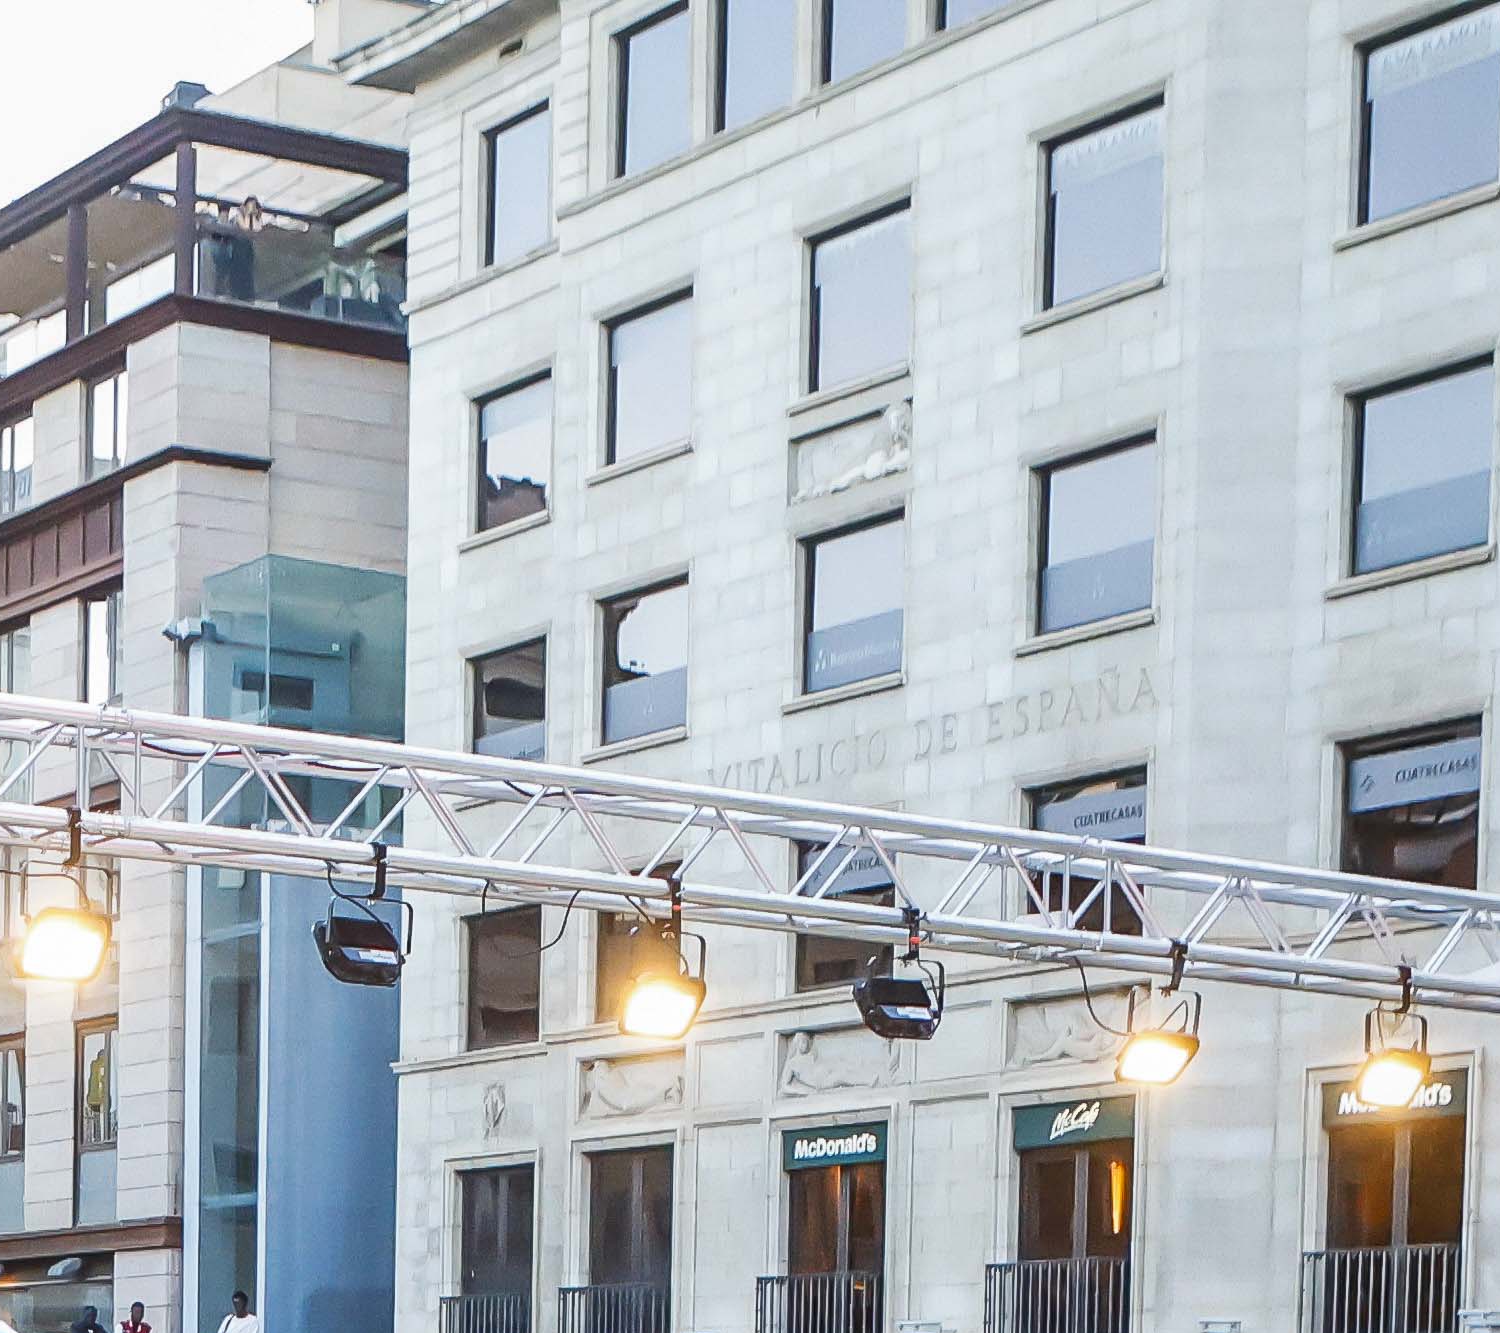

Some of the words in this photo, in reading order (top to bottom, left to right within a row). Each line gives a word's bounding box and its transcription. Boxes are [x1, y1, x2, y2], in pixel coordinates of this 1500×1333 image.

[914, 713, 959, 761] DE
[986, 666, 1158, 744] ESPAÑA
[794, 1132, 877, 1160] McDonald's
